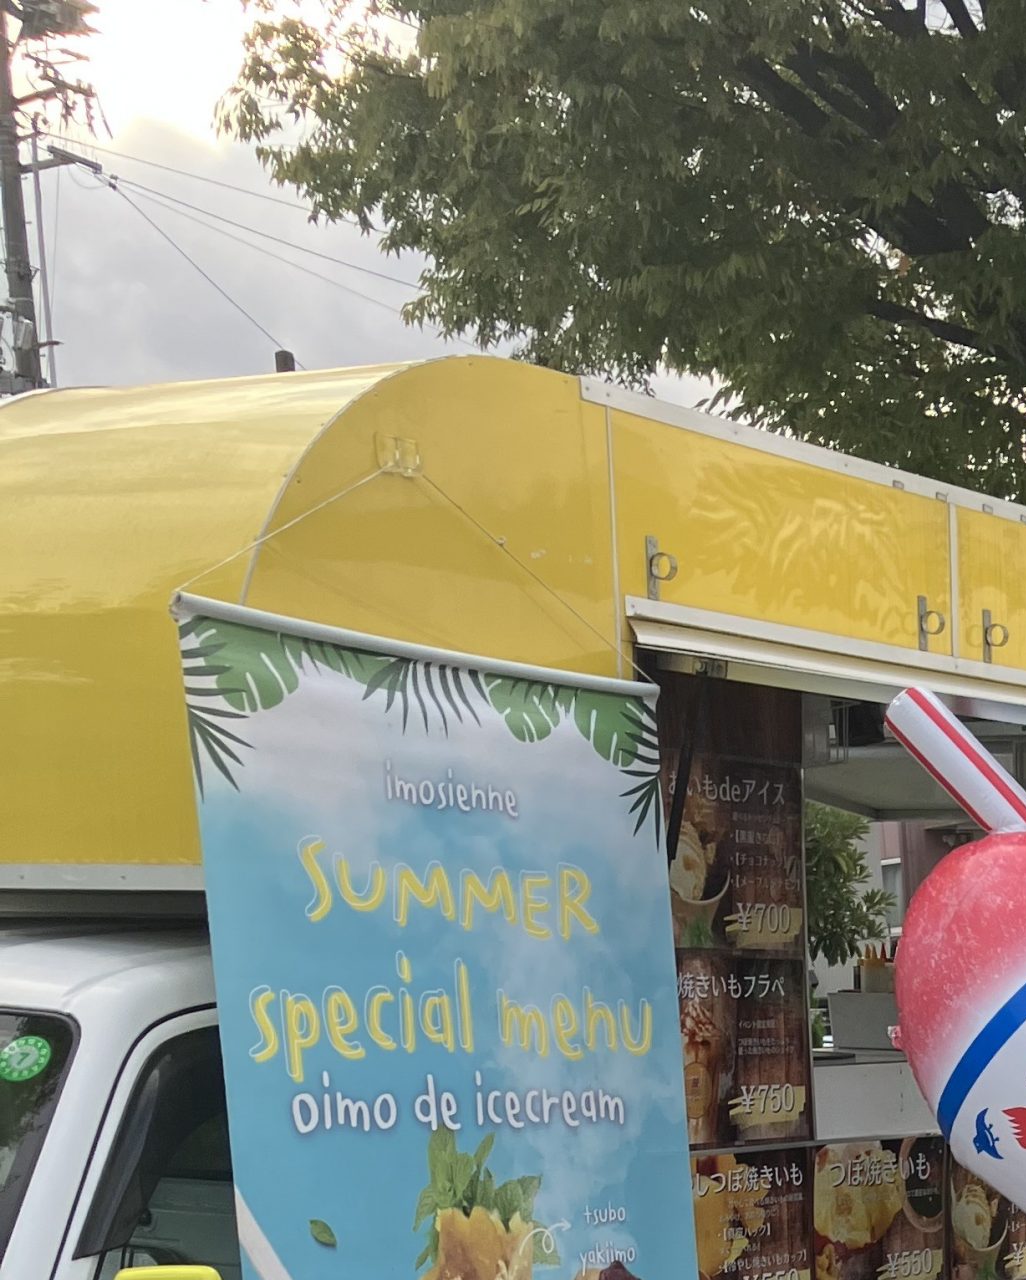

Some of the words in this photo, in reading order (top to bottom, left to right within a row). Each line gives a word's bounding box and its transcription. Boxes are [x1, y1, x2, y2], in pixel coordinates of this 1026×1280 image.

[384, 761, 519, 817] imosienne
[297, 835, 599, 939] SUMMER
[736, 902, 791, 932] ¥700
[677, 972, 785, 999] 焼きいもフラペ
[248, 950, 475, 1082] special
[496, 986, 652, 1060] menu
[291, 1070, 397, 1134] oimo
[414, 1074, 461, 1131] de
[475, 1070, 624, 1129] icecream
[740, 1083, 795, 1115] ¥750
[692, 1163, 804, 1197] しつぼ焼きいも
[829, 1152, 931, 1188] つぼ焼きいも
[584, 1204, 626, 1224] tsubo
[579, 1241, 636, 1277] yakiimo
[886, 1248, 933, 1279] ¥550
